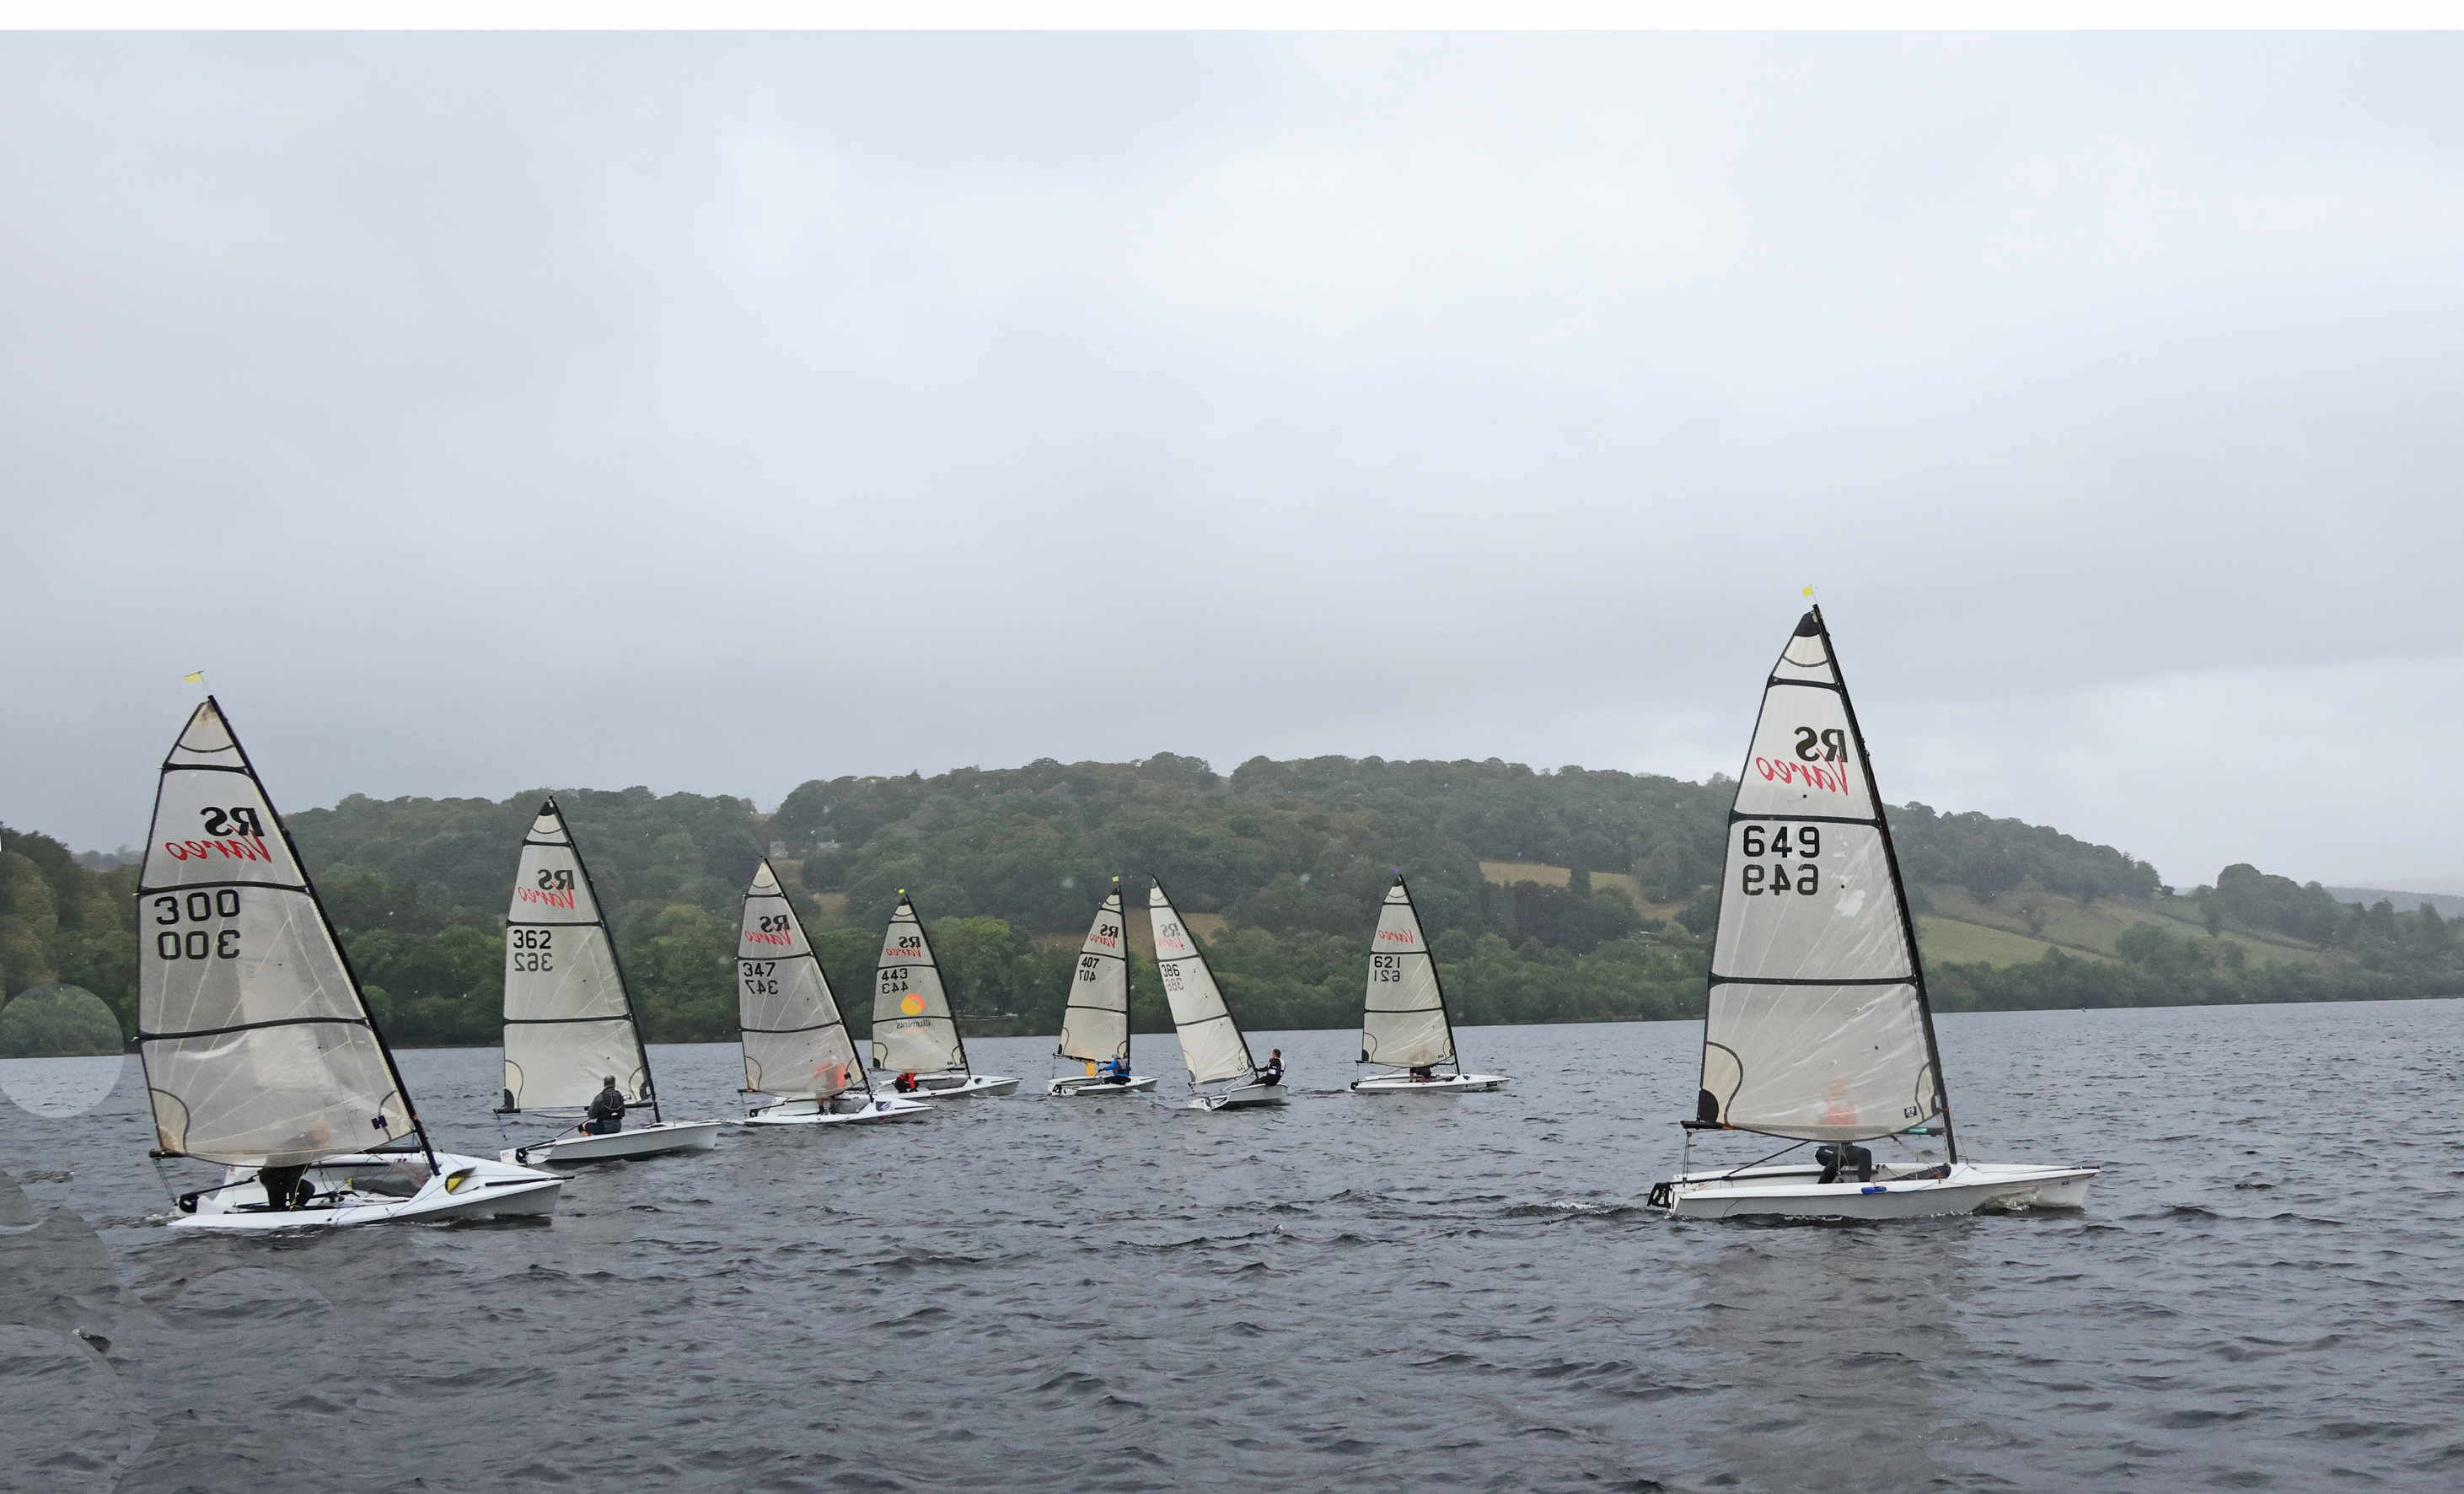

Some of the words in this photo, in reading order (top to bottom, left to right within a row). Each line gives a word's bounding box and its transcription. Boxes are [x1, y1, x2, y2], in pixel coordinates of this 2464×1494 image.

[1742, 825, 1820, 858] 649
[154, 889, 240, 925] 300
[513, 929, 552, 949] 362
[743, 961, 776, 978] 347
[1081, 956, 1100, 969] 407
[1374, 955, 1401, 969] 621
[881, 967, 909, 982] 443
[1161, 964, 1180, 978] 386
